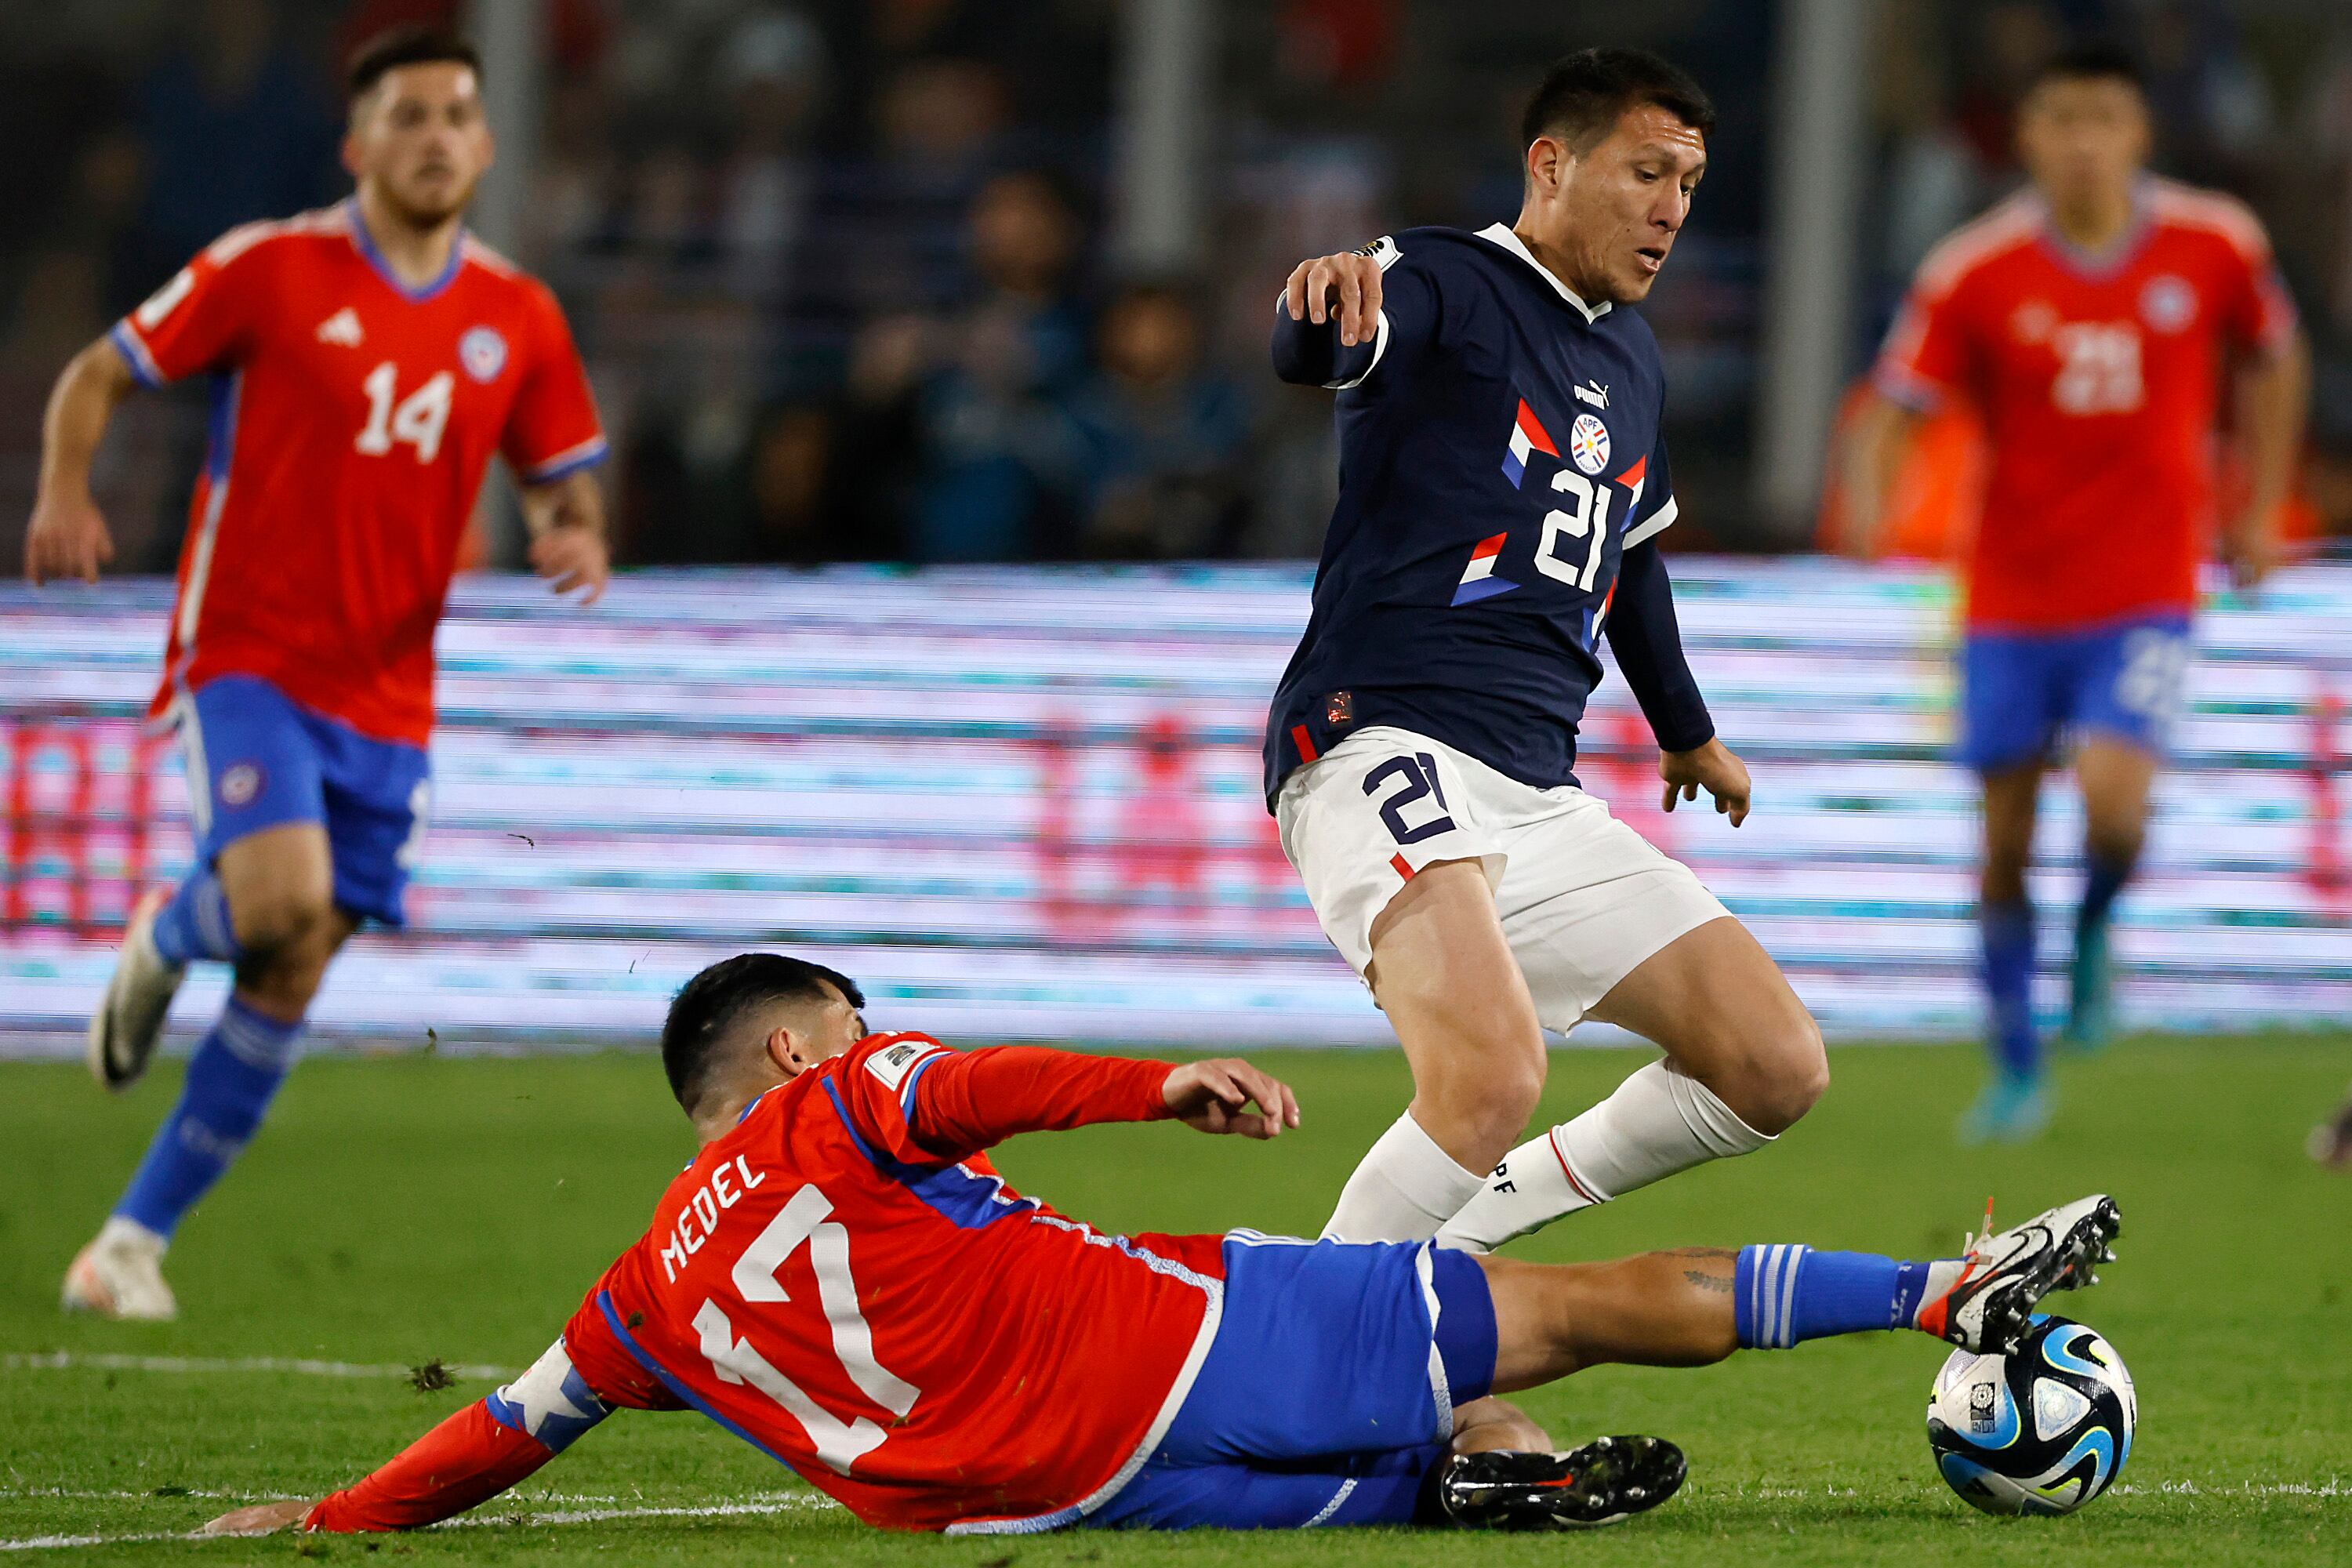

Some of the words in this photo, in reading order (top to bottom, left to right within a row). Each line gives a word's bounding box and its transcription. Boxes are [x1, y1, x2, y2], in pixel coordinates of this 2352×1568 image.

[355, 361, 454, 464] 14
[1583, 417, 1598, 430] APF
[1534, 470, 1612, 593] 21
[1362, 752, 1457, 845] 21
[660, 1154, 765, 1284] MEDEL
[691, 1184, 921, 1475] 17
